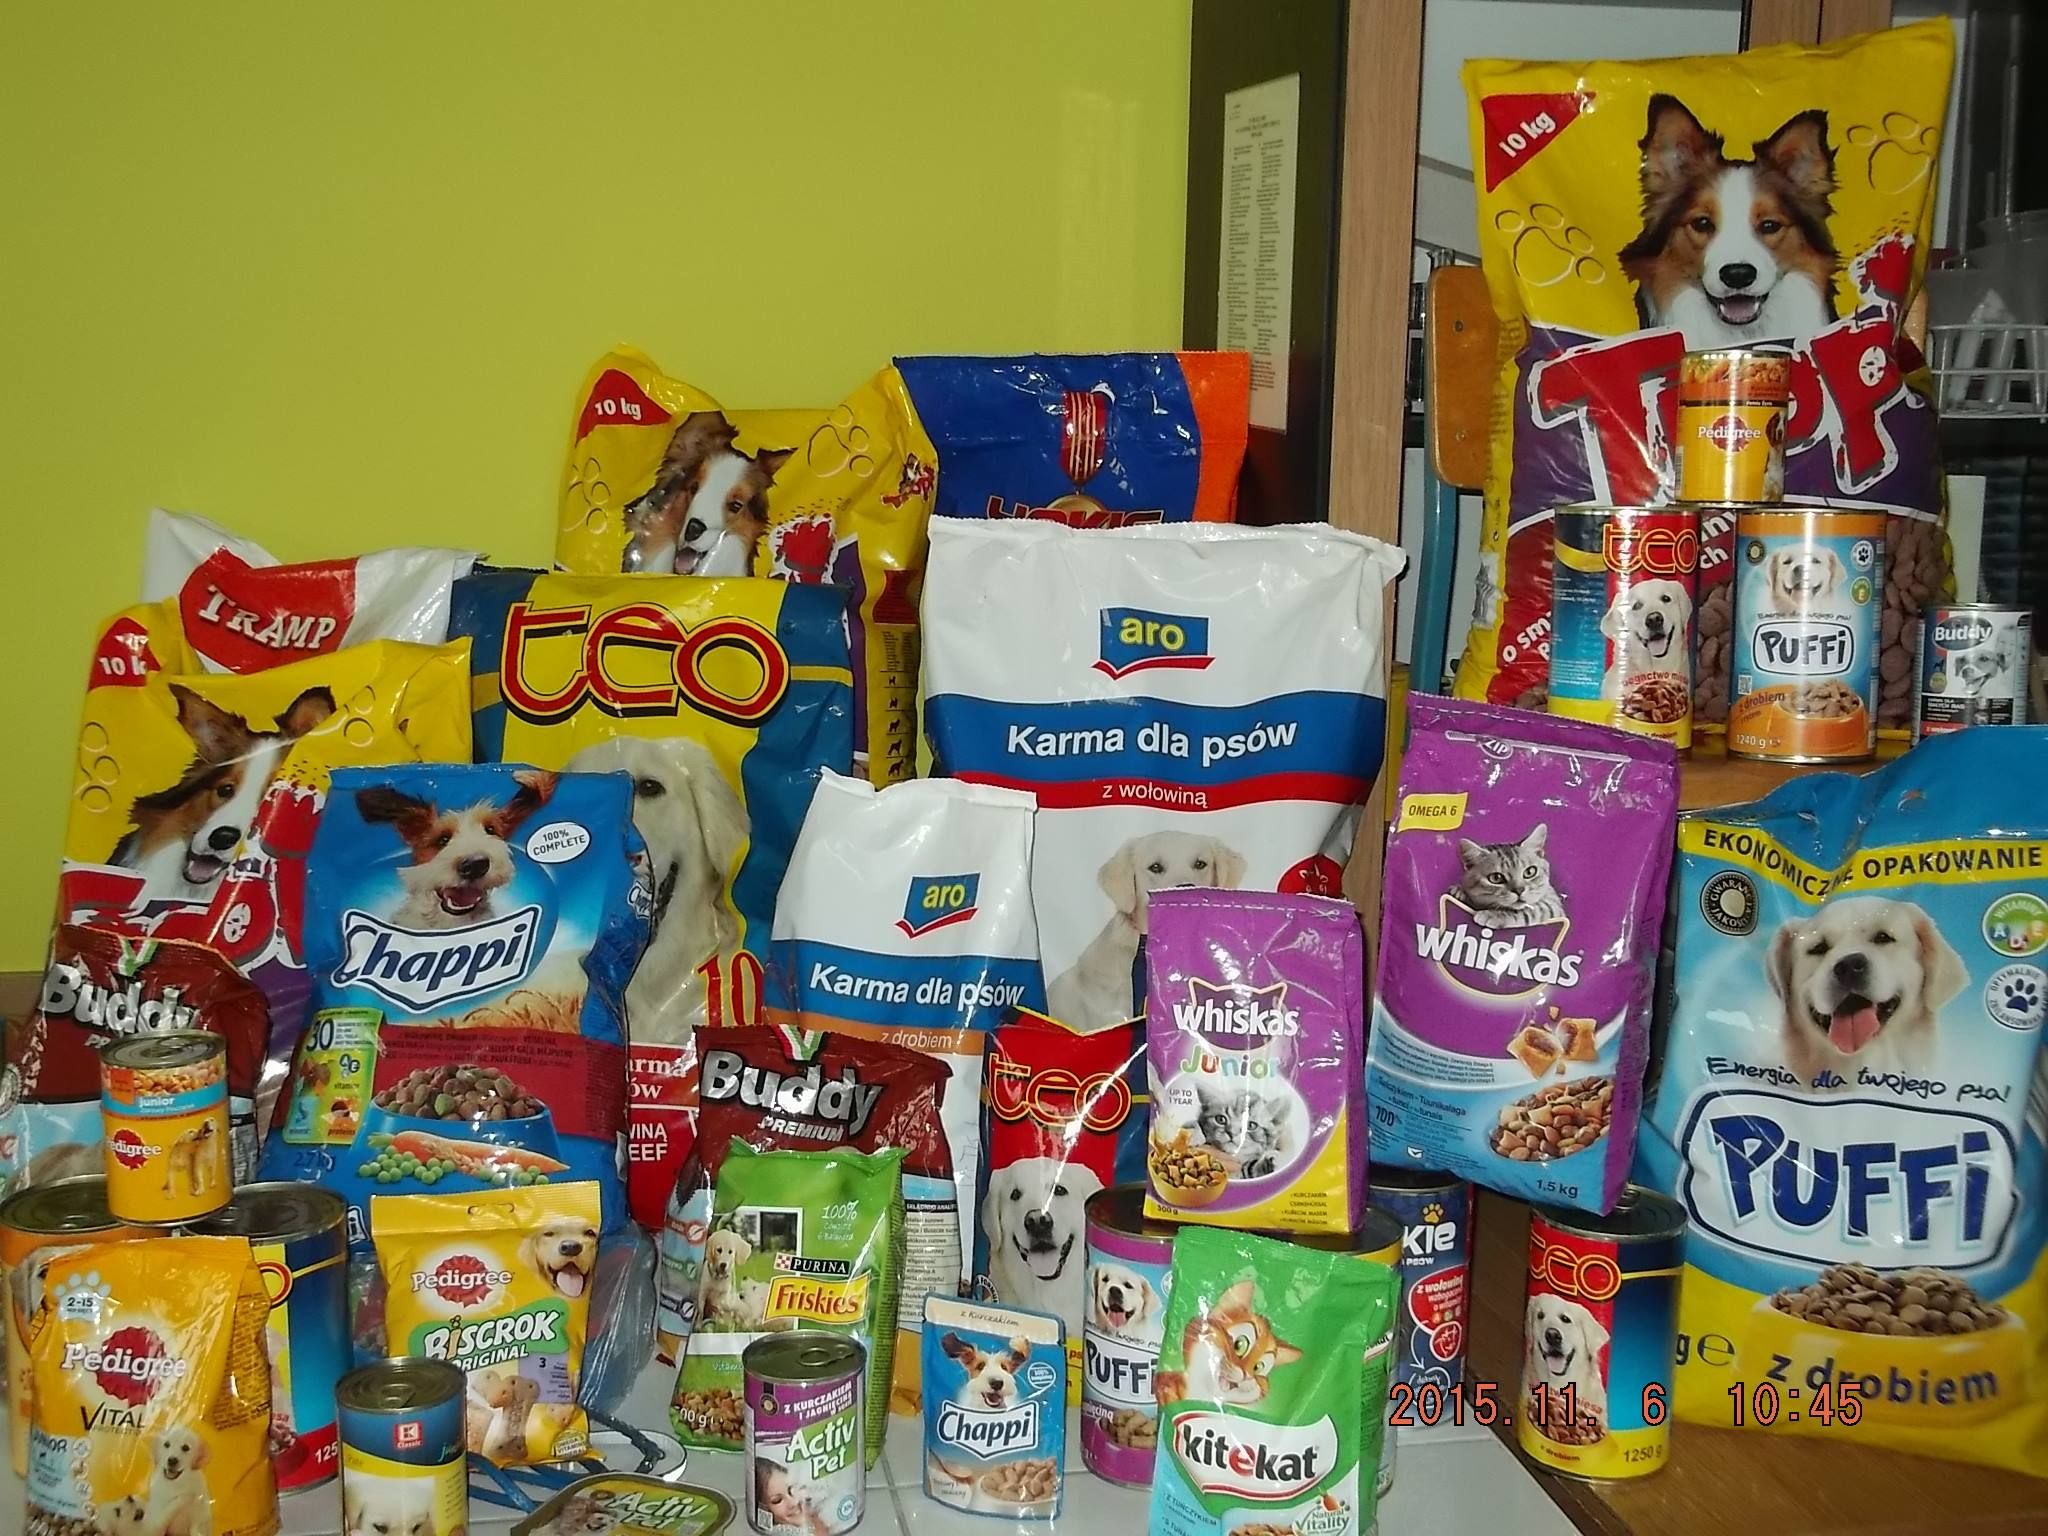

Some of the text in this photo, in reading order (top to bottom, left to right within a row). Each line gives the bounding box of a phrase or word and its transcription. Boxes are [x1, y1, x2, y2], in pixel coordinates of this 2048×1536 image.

[1498, 109, 1557, 160] 10 kg
[594, 399, 642, 422] 10 kg
[1697, 424, 1762, 443] Pedigree
[1119, 615, 1185, 652] aro
[1934, 624, 1992, 642] Buddy
[99, 655, 126, 677] 10
[1007, 721, 1299, 768] Karma dla psów
[1486, 738, 1508, 755] ZIP
[1102, 783, 1209, 809] z wołowiną
[1408, 804, 1457, 818] OMEGA 6
[532, 834, 588, 857] COMPLETE
[541, 828, 570, 843] 100%
[1862, 846, 2043, 880] OPAKOWANIE
[922, 881, 966, 909] aro
[332, 922, 528, 993] Chappi
[809, 962, 1025, 1011] Karma dla psów
[891, 1029, 953, 1049] drobiem
[1180, 1052, 1280, 1081] Junior
[700, 1050, 885, 1136] Buddy
[1169, 1088, 1193, 1098] UP TO
[1706, 1056, 2011, 1104] Energia dla twojego psa!
[1174, 1097, 1193, 1106] YEAR
[758, 1114, 845, 1143] PREMIUM
[1559, 1179, 1579, 1199] kg
[1708, 1114, 1993, 1243] PUFFi
[821, 1199, 859, 1221] 100%
[792, 1258, 847, 1274] PURINA
[411, 1267, 513, 1293] Pedigree
[67, 1296, 94, 1308] 2-15
[775, 1283, 860, 1315] Friskies
[61, 1343, 187, 1382] Pedigree
[539, 1357, 546, 1368] 3
[1805, 1356, 1998, 1406] drobiem
[80, 1402, 146, 1432] VITAL
[698, 1413, 707, 1427] g
[783, 1402, 792, 1414] Z
[787, 1414, 857, 1461] Activ
[938, 1410, 1032, 1448] Chappi
[811, 1448, 846, 1479] Pet
[1182, 1423, 1318, 1482] kitekat
[1623, 1446, 1654, 1463] 1250
[608, 1491, 709, 1519] Activ
[1312, 1509, 1346, 1520] Natural
[627, 1512, 676, 1530] Pet
[1294, 1514, 1351, 1532] Vitality
